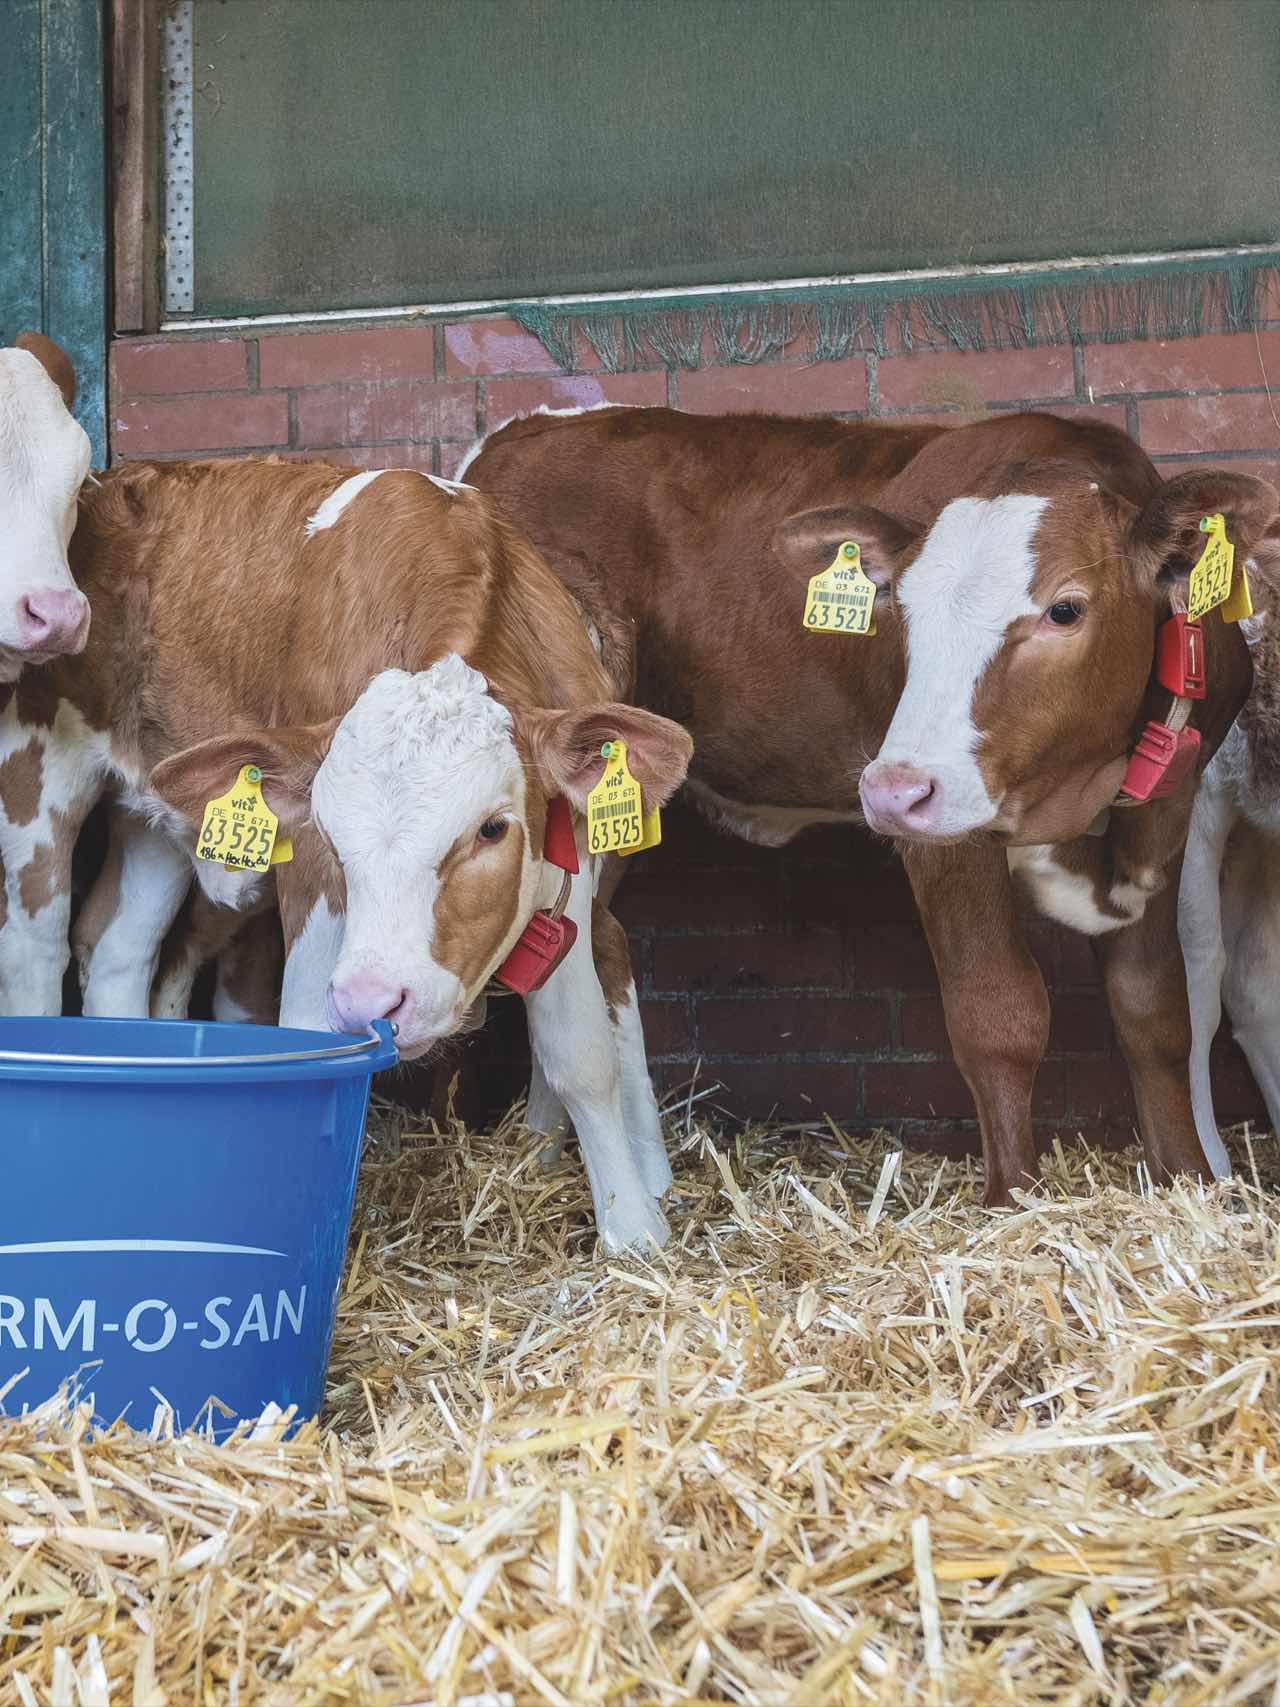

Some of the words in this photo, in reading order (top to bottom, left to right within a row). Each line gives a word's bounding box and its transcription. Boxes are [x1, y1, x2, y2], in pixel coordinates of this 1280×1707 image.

[854, 584, 870, 594] 671
[592, 794, 603, 805] DE
[608, 791, 618, 801] 03
[623, 787, 636, 798] 671
[212, 807, 226, 818] DE
[232, 812, 245, 821] 03
[251, 816, 269, 827] 671
[200, 846, 217, 860] 186
